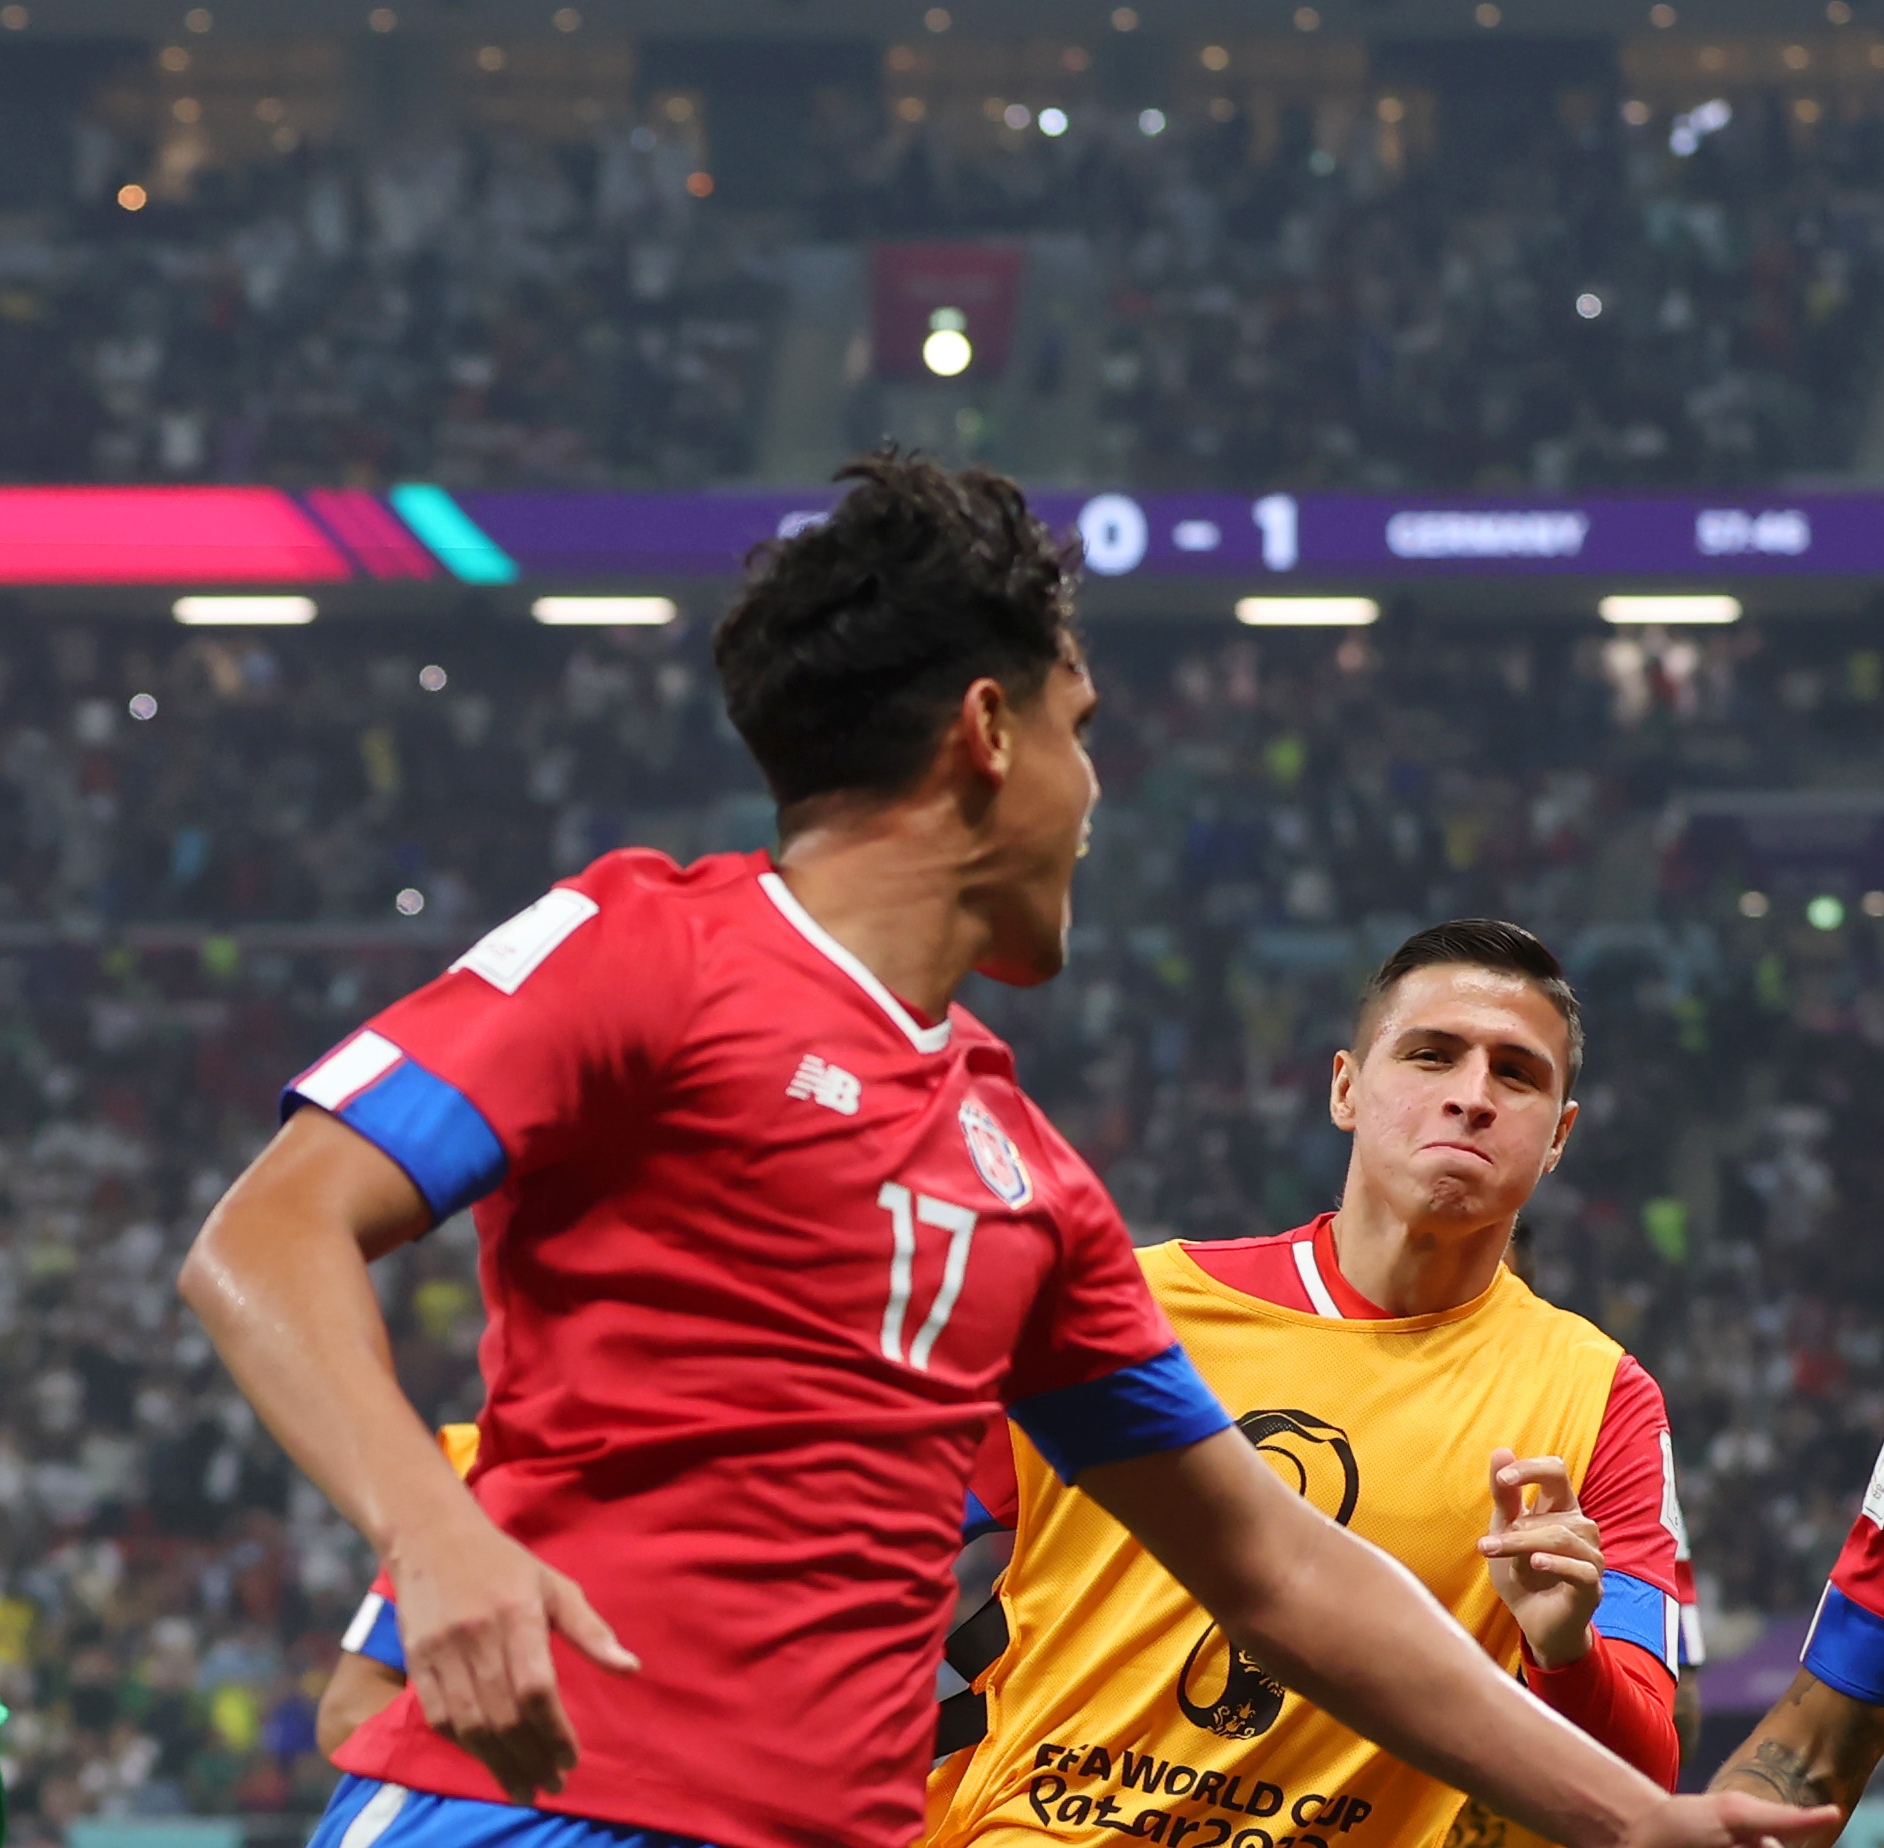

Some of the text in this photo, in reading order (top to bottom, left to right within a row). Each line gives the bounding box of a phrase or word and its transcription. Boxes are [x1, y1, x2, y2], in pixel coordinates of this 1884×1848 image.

[1079, 493, 1147, 574] 0
[1253, 493, 1297, 570] 1
[1385, 511, 1589, 557] GERMANY
[877, 1182, 978, 1371] 17
[1121, 1750, 1285, 1819] WORLD
[1292, 1793, 1373, 1833] CUP
